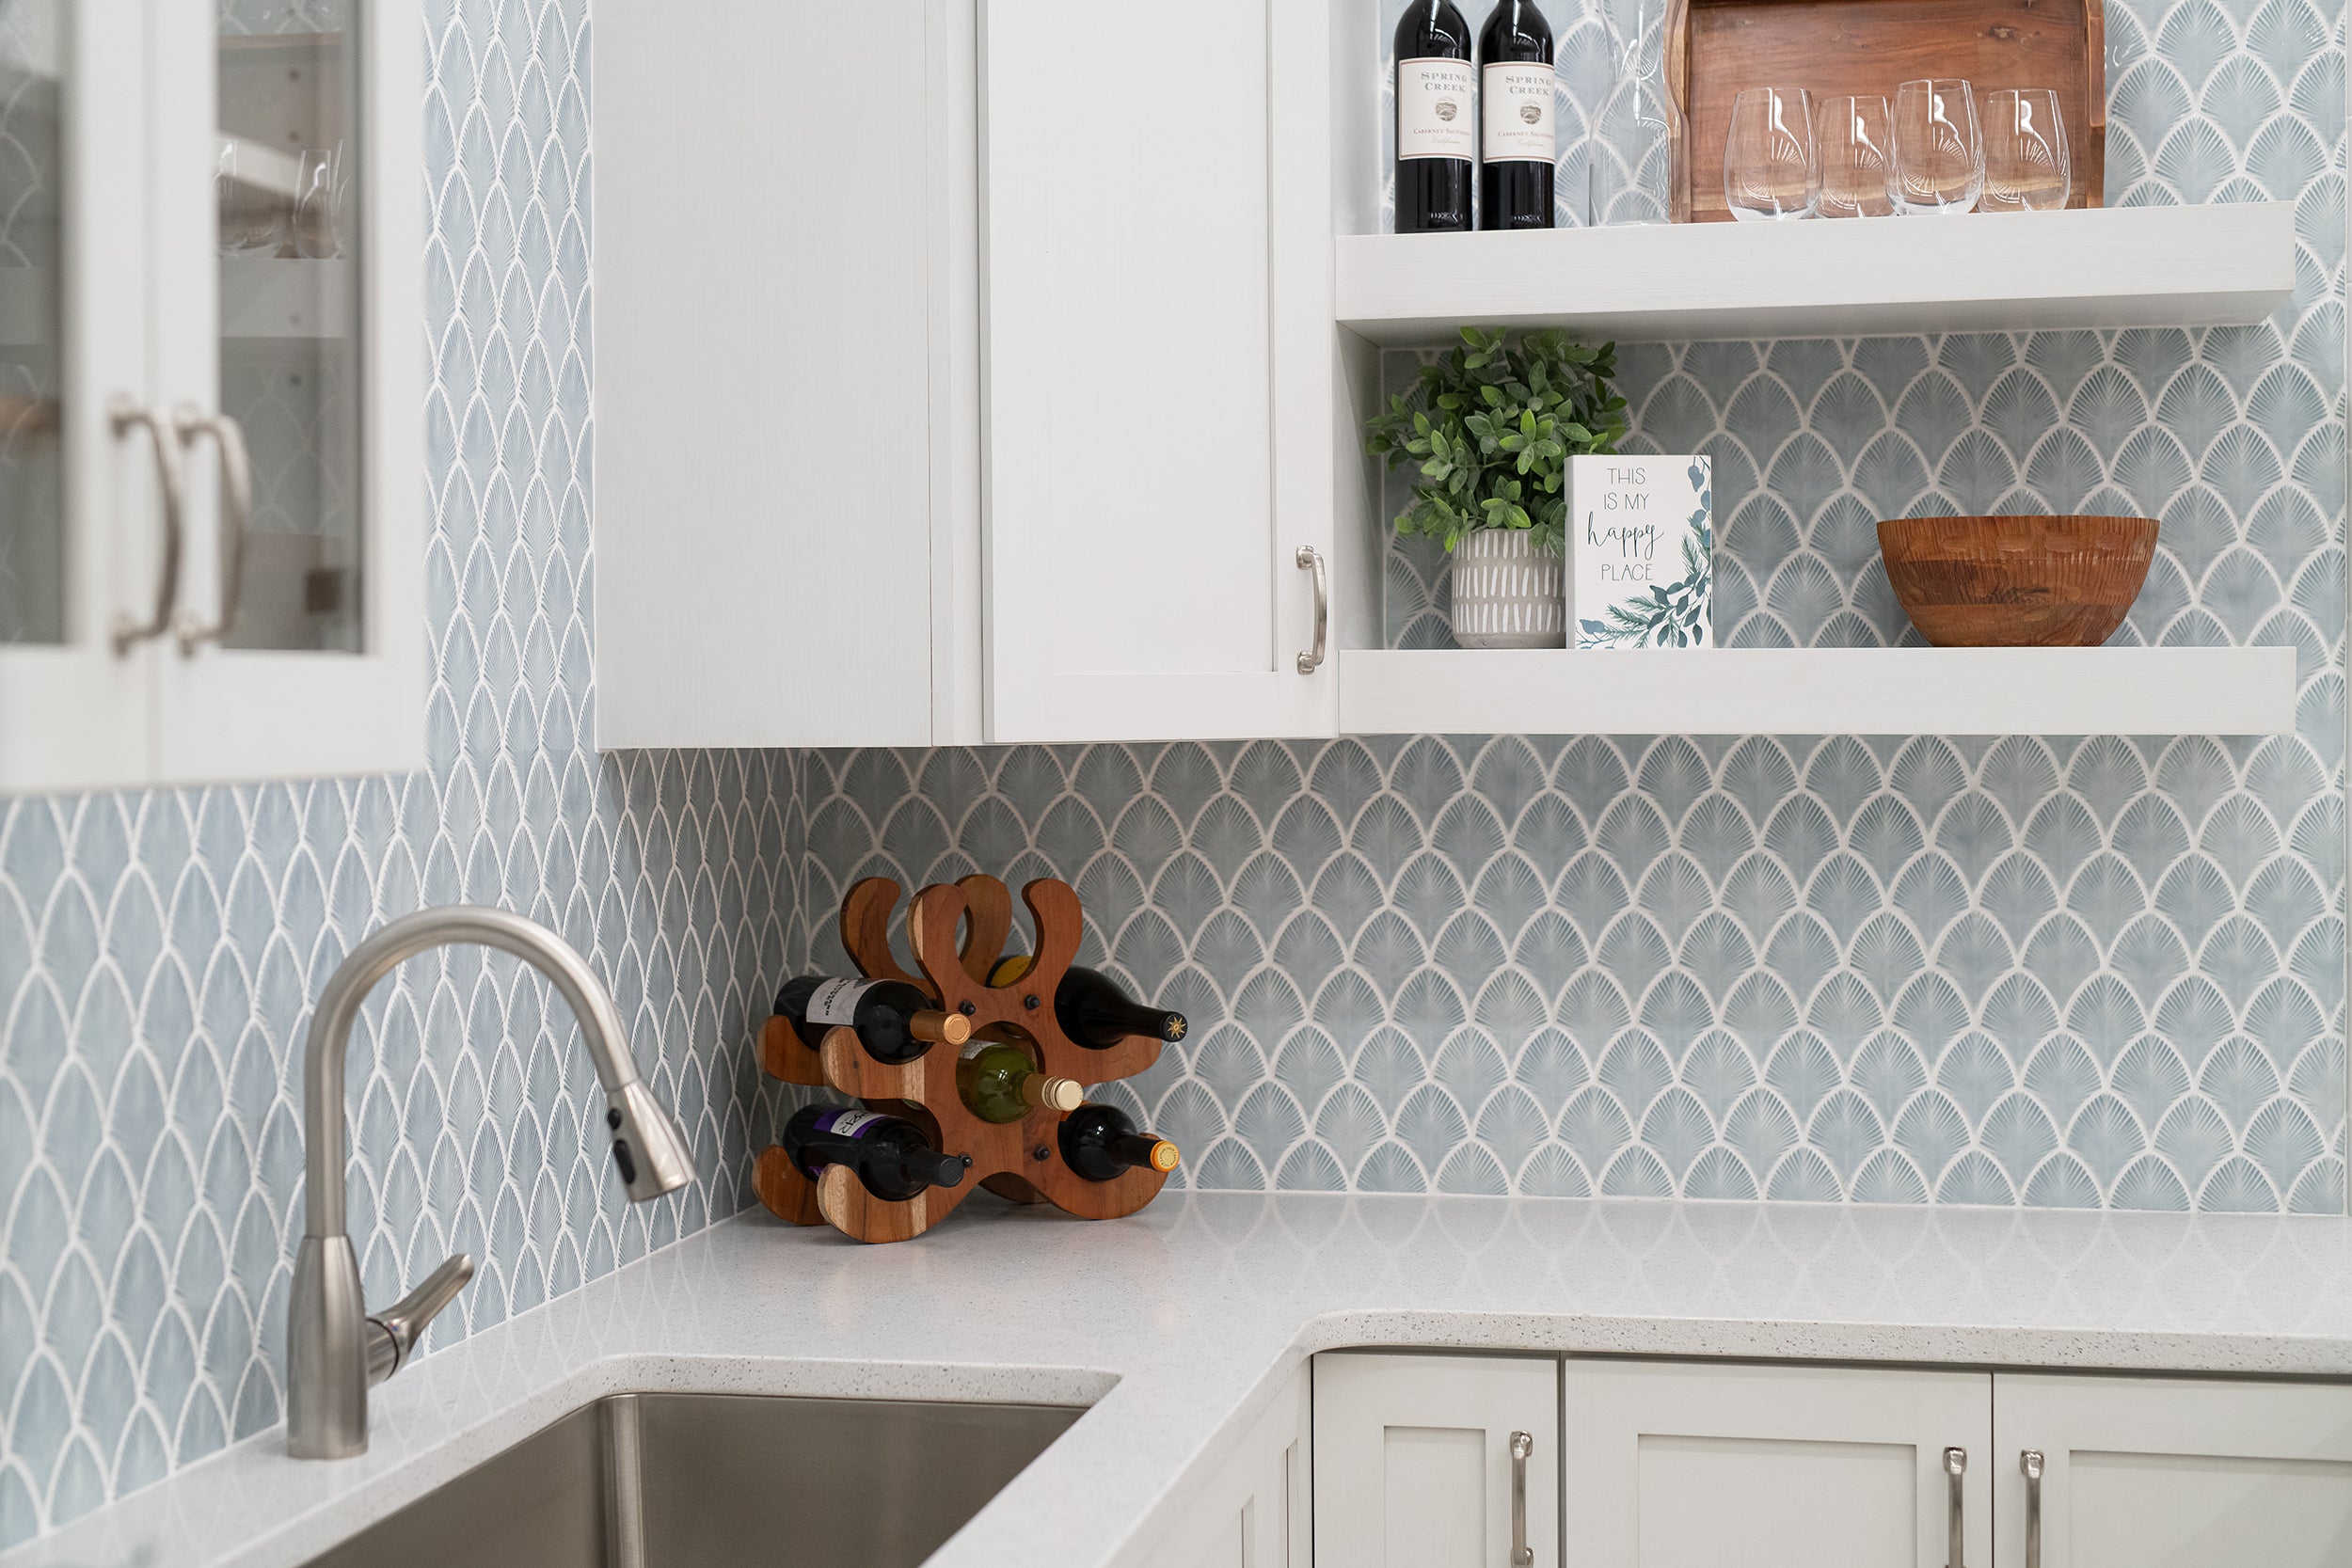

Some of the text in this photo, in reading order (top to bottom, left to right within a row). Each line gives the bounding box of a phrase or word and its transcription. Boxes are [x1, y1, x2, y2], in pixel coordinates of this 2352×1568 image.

[1421, 72, 1467, 82] SPRING
[1505, 75, 1551, 86] SPRING
[1424, 82, 1465, 92] CREEK
[1509, 86, 1549, 95] CREEK
[1607, 467, 1645, 485] THIS
[1603, 492, 1649, 511] IS MY
[1587, 511, 1664, 561] happy
[1601, 562, 1653, 581] PLACE
